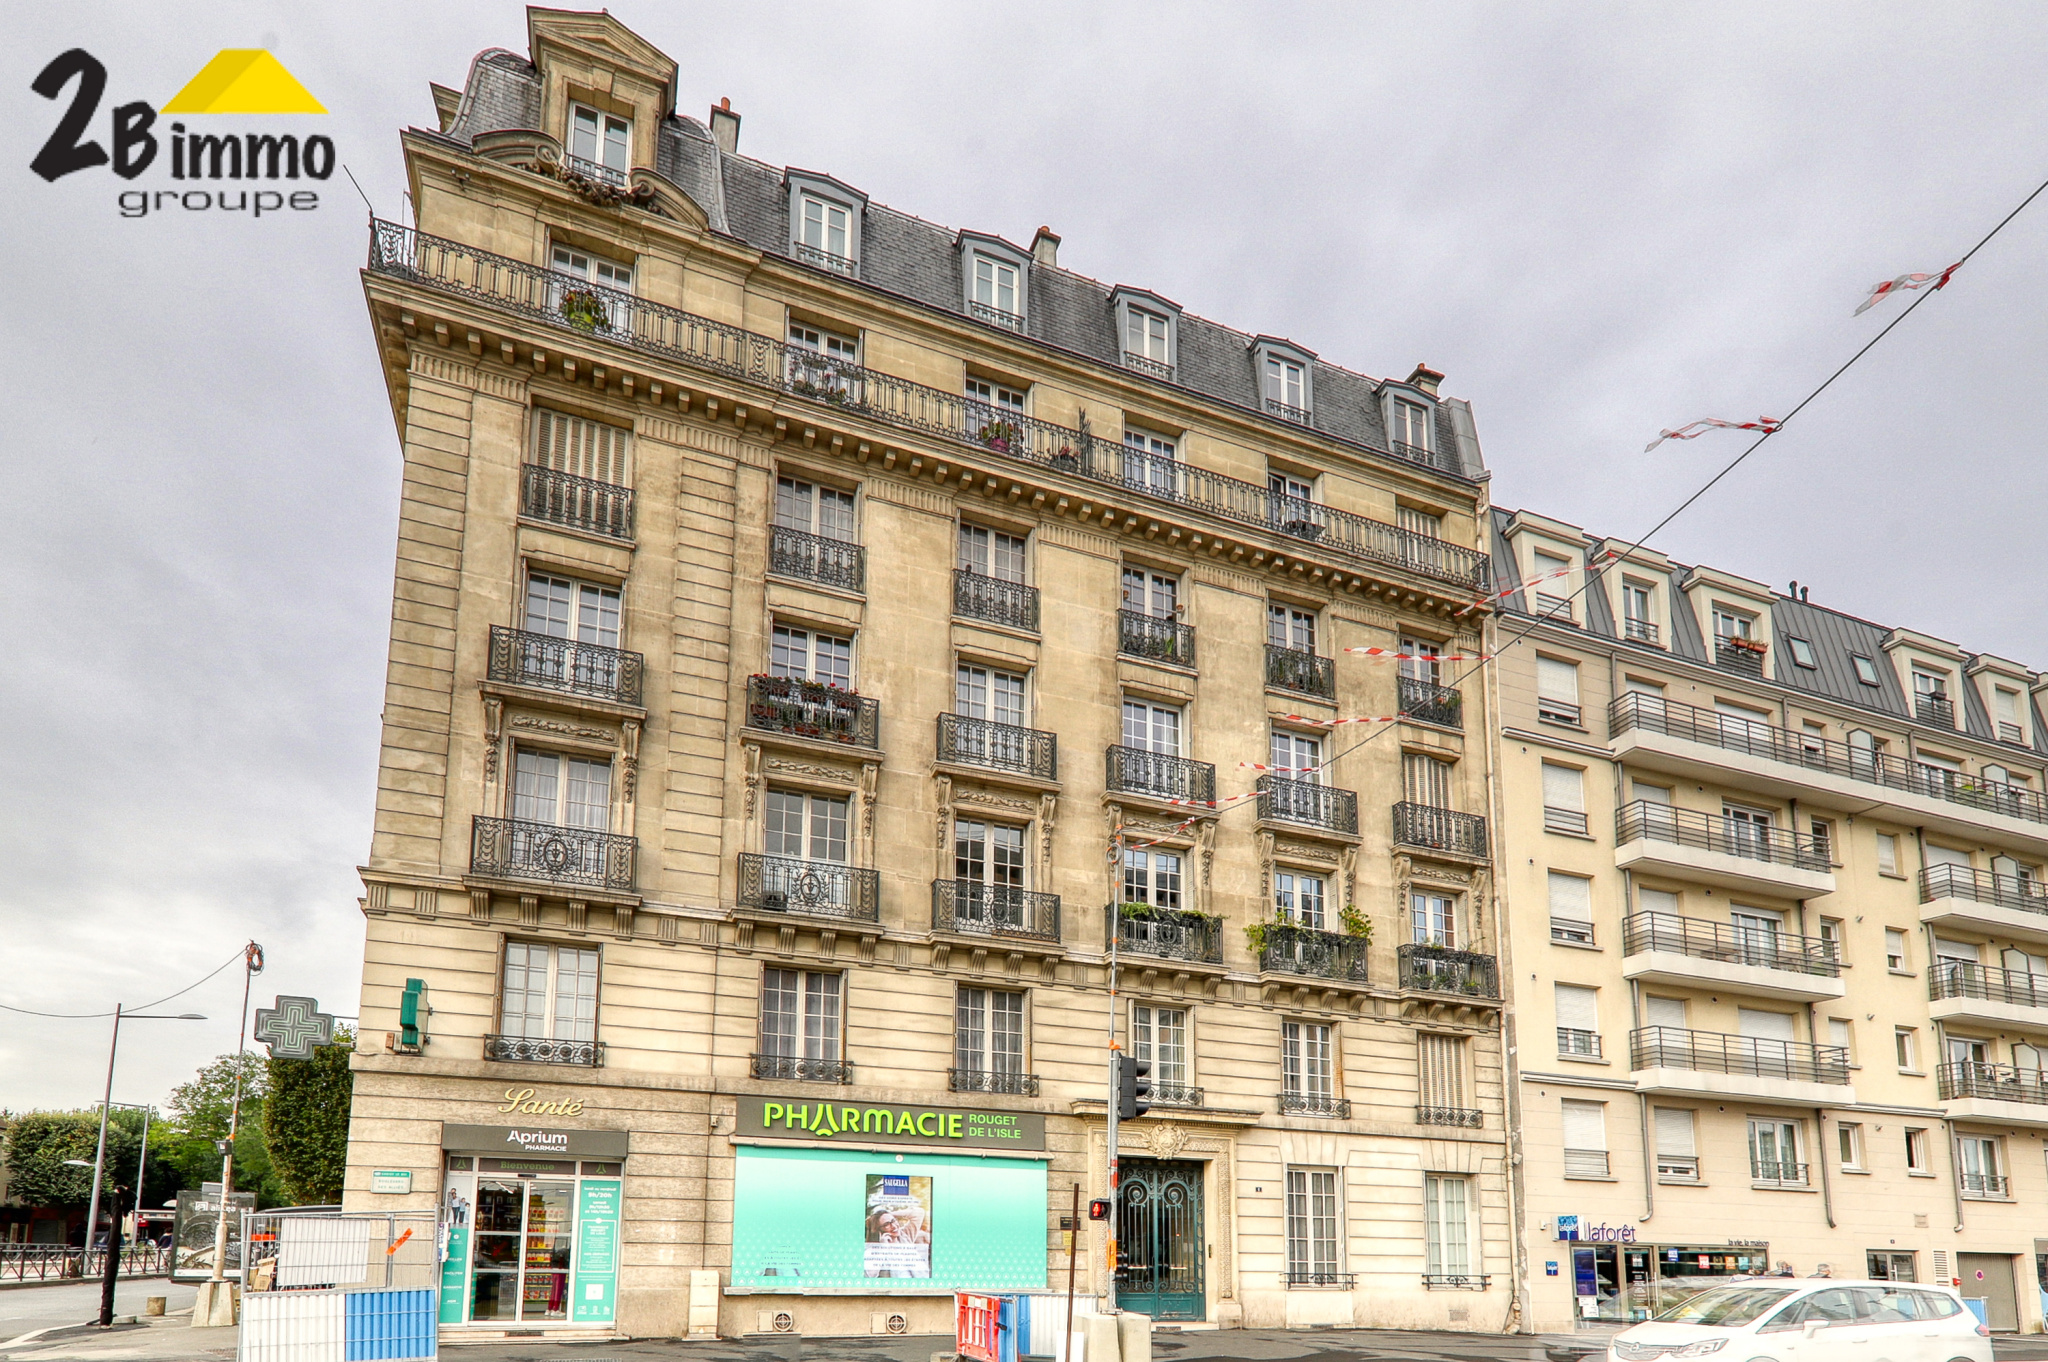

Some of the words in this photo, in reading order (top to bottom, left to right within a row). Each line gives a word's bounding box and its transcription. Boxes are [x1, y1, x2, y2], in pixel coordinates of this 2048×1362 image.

[498, 1087, 584, 1117] Santé
[763, 1102, 964, 1138] PHARMACIE
[968, 1113, 1018, 1126] ROUGET
[507, 1130, 568, 1145] Aprium
[968, 1127, 985, 1138] DE
[987, 1127, 1022, 1139] L'ISLE
[524, 1144, 568, 1152] PHARMACIE
[500, 1161, 555, 1171] Bienvenue
[884, 1178, 908, 1187] SAUGELLA
[1587, 1221, 1637, 1242] laforêt
